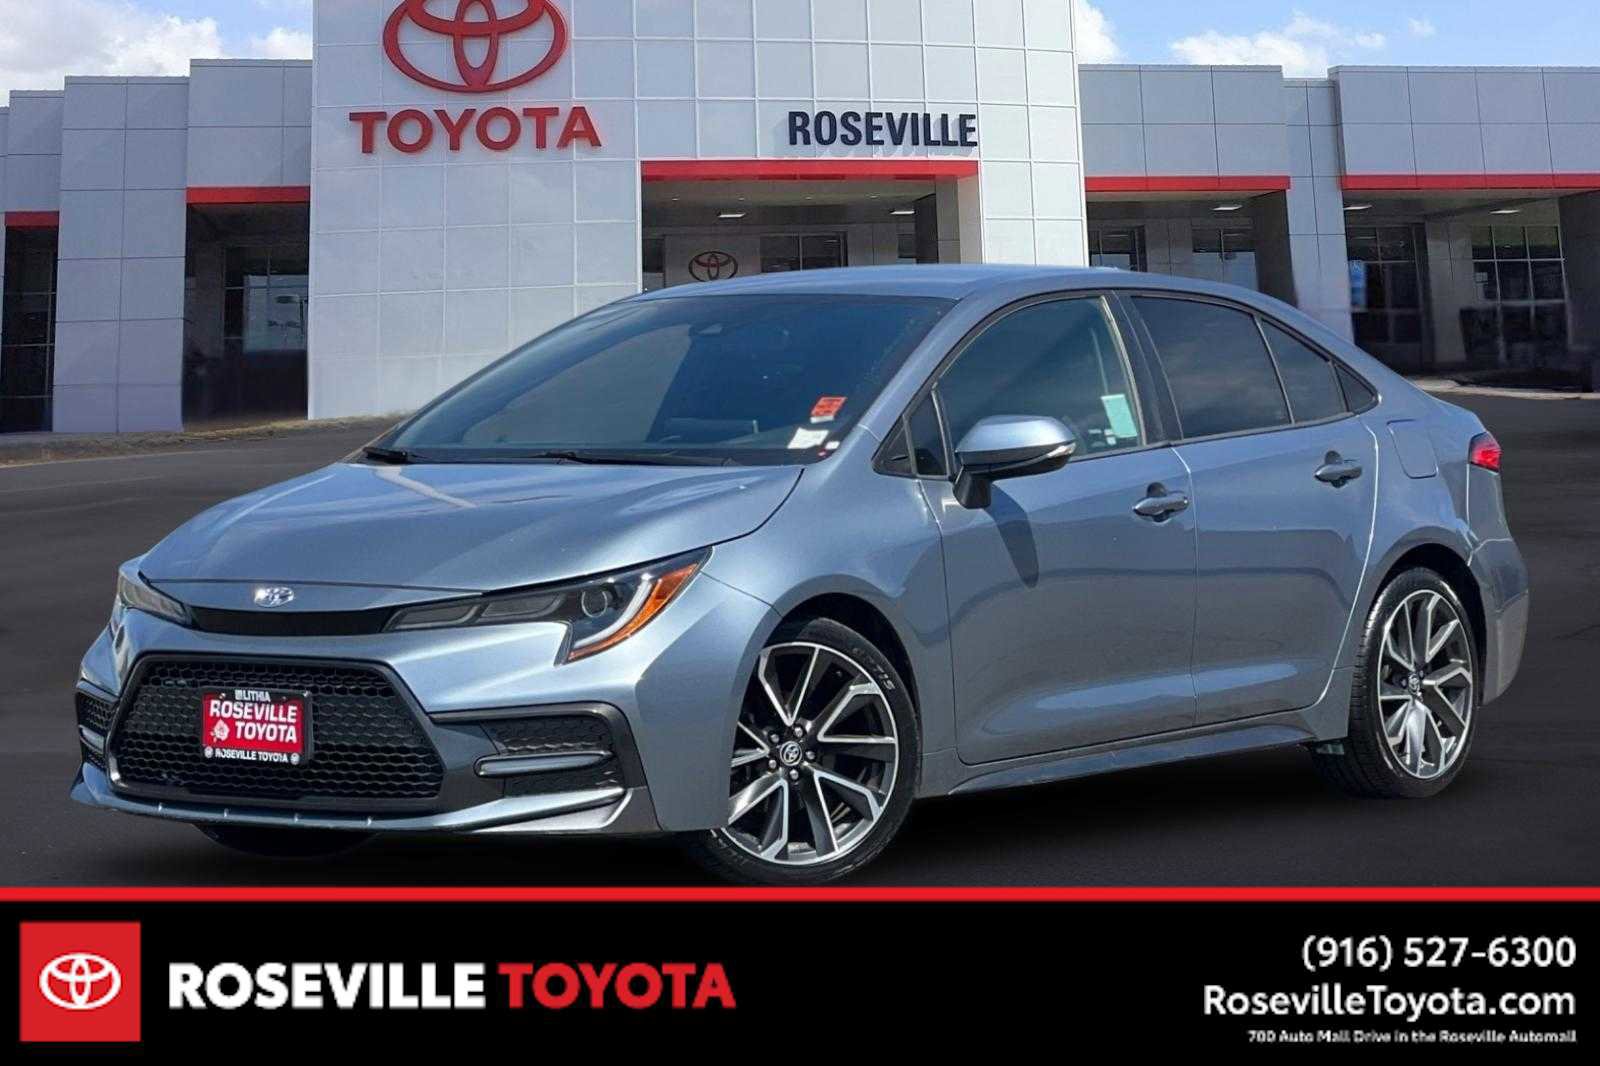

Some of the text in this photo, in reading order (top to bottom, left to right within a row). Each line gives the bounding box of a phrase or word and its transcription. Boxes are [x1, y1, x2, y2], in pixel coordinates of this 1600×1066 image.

[349, 106, 602, 154] TOYOTA
[788, 110, 978, 147] ROSEVILLE
[209, 699, 298, 723] ROSEVILLE
[235, 721, 297, 744] TOYOTA
[215, 748, 288, 762] ROSEVILLE TOYOTA
